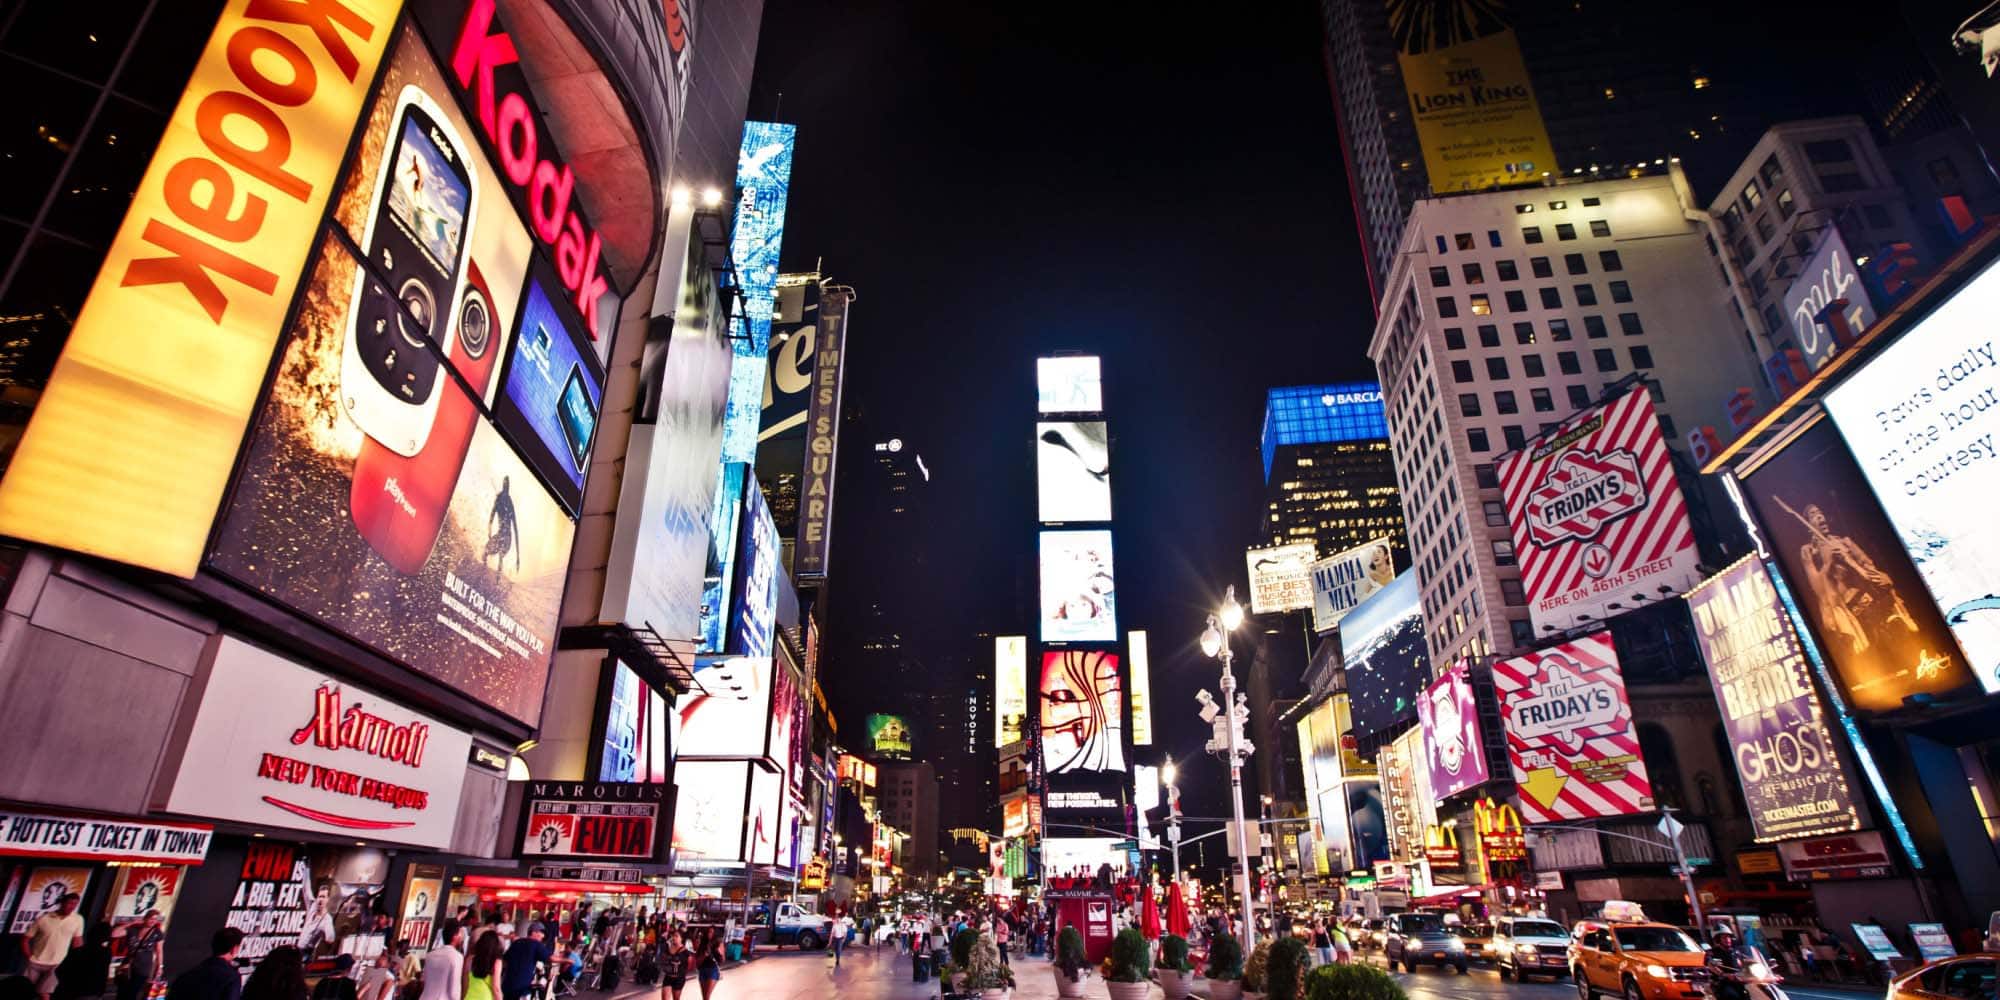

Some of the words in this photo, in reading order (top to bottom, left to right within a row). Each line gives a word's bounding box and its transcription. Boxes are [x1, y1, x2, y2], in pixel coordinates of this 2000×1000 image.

[1444, 67, 1486, 87] THE
[119, 0, 376, 327] Kodak
[453, 0, 609, 342] Kodak
[817, 314, 842, 406] TIMES
[1936, 341, 1998, 392] daily
[1939, 386, 2000, 431] hour
[804, 416, 833, 542] SQUARE
[1904, 433, 1997, 497] courtesy
[445, 570, 470, 600] BUILT
[468, 587, 486, 611] FOR
[485, 601, 501, 623] THE
[1256, 582, 1281, 593] THE
[1315, 557, 1366, 594] MAMMA
[1327, 582, 1359, 612] MIA!
[1539, 596, 1569, 612] HERE
[1572, 588, 1589, 600] ON
[1592, 575, 1624, 594] 46TH
[1626, 556, 1674, 581] STREET
[1518, 687, 1611, 727] FRIDAY'S
[1722, 654, 1810, 721] BEFORE
[291, 684, 430, 768] Marriott
[968, 696, 977, 754] NOVOTEL
[1521, 752, 1557, 769] HERE
[1737, 720, 1835, 783] GHOST
[258, 752, 311, 785] NEW
[312, 764, 362, 796] YORK
[359, 777, 430, 811] MARQUIS
[533, 784, 664, 799] MARQUIS
[1047, 792, 1066, 800] NEW
[1386, 752, 1408, 837] PALACE
[6, 816, 86, 847] HOTTEST
[87, 822, 143, 851] TICKET
[140, 829, 162, 852] IN
[162, 829, 208, 855] TOWN!
[575, 815, 648, 855] EVITA
[241, 844, 296, 880] EVITA
[291, 860, 305, 882] IS
[231, 882, 246, 908] A
[225, 909, 307, 935] HIGH-OCTANE
